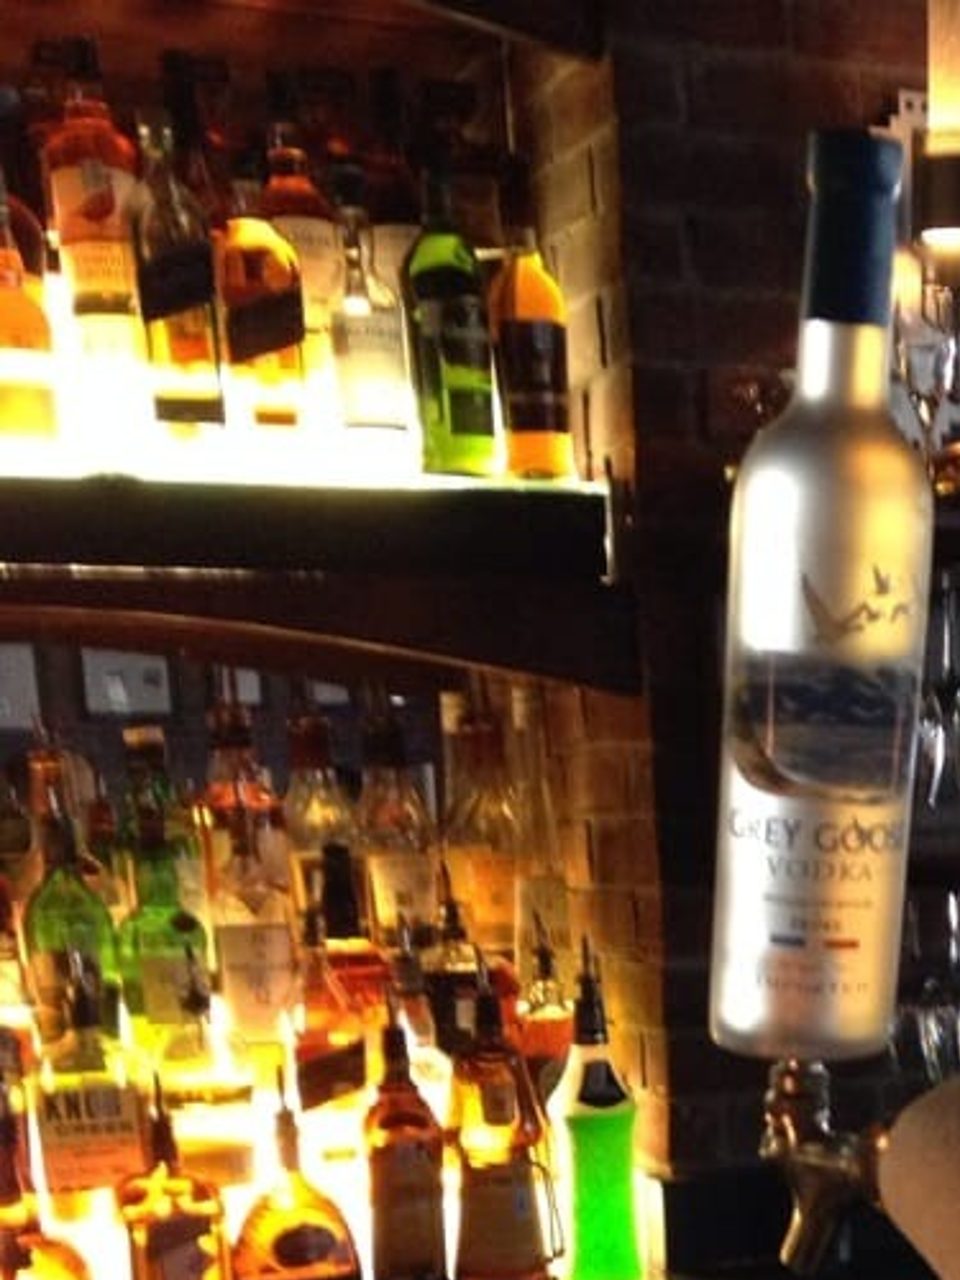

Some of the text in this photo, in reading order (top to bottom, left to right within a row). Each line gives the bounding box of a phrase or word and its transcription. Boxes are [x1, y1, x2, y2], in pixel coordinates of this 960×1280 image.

[728, 809, 904, 854] GREY GOOS
[766, 856, 872, 883] VODKA
